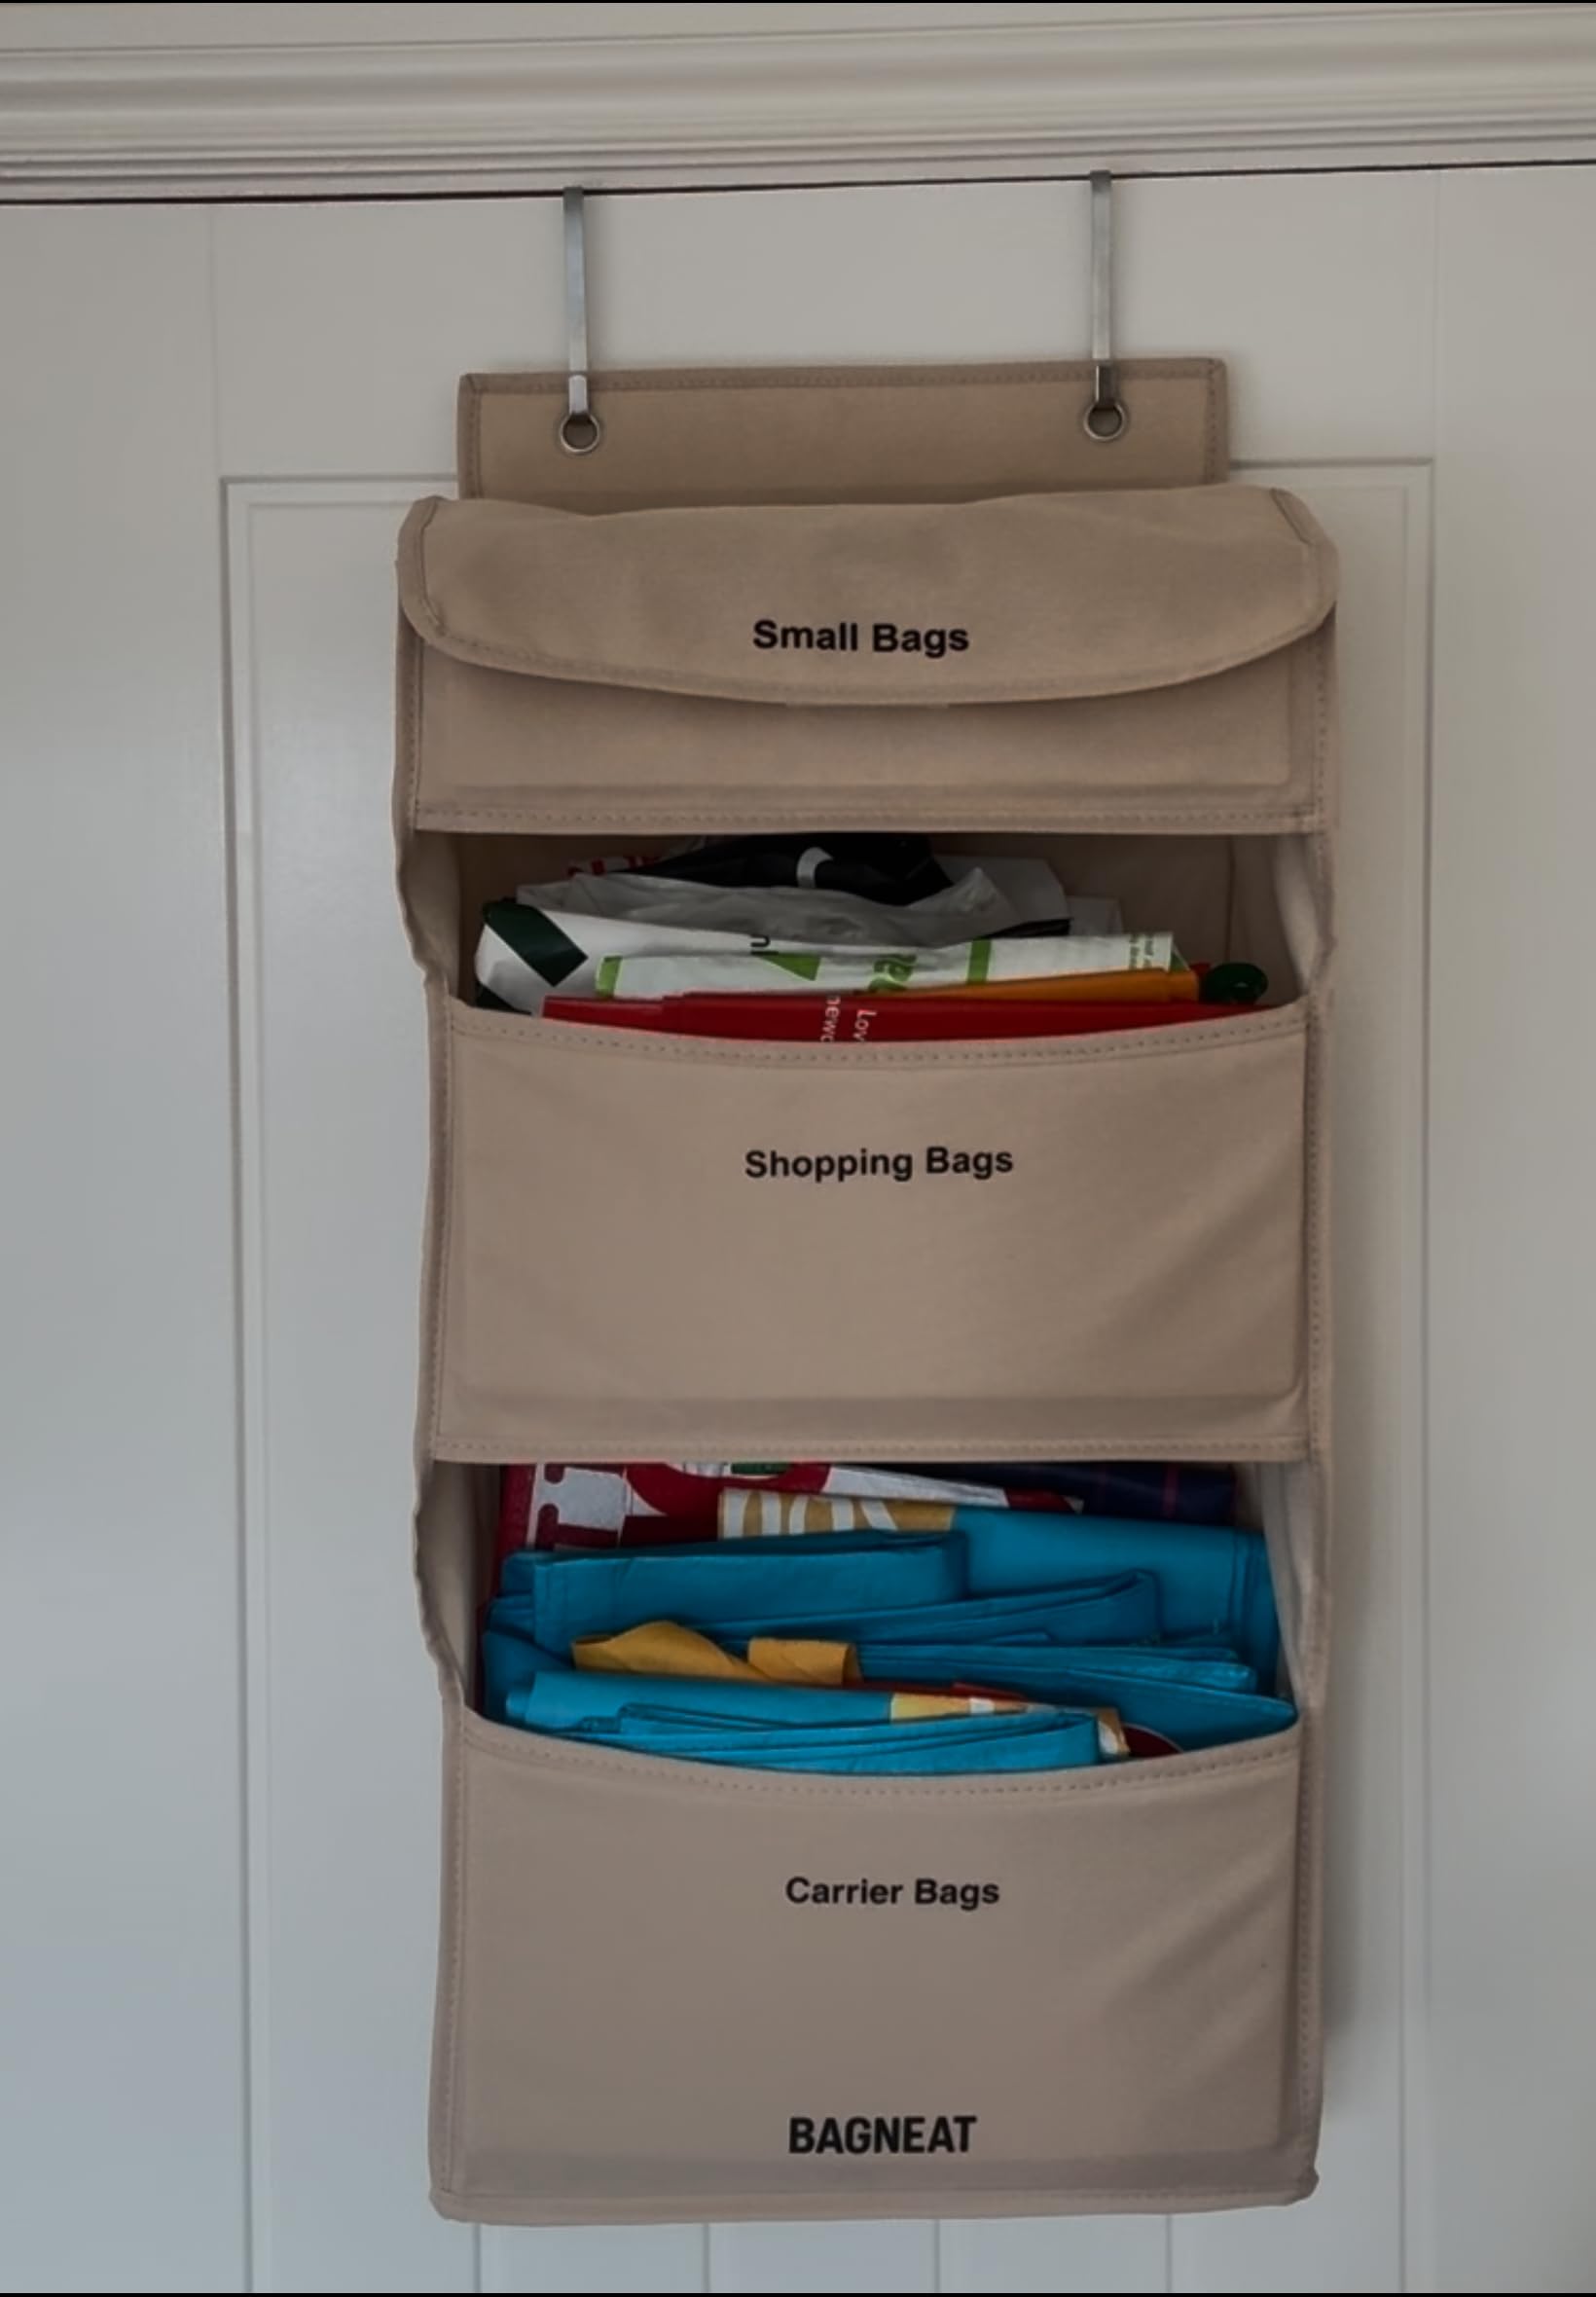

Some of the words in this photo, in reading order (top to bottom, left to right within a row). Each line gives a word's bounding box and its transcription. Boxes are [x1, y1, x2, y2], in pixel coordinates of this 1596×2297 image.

[752, 619, 858, 651] Small
[872, 623, 970, 659] Bags
[745, 1148, 913, 1183] Shopping
[925, 1147, 1014, 1180] Bags
[785, 1876, 904, 1905] Carrier
[914, 1878, 1000, 1911] Bags
[788, 2115, 978, 2155] BAGNEAT
